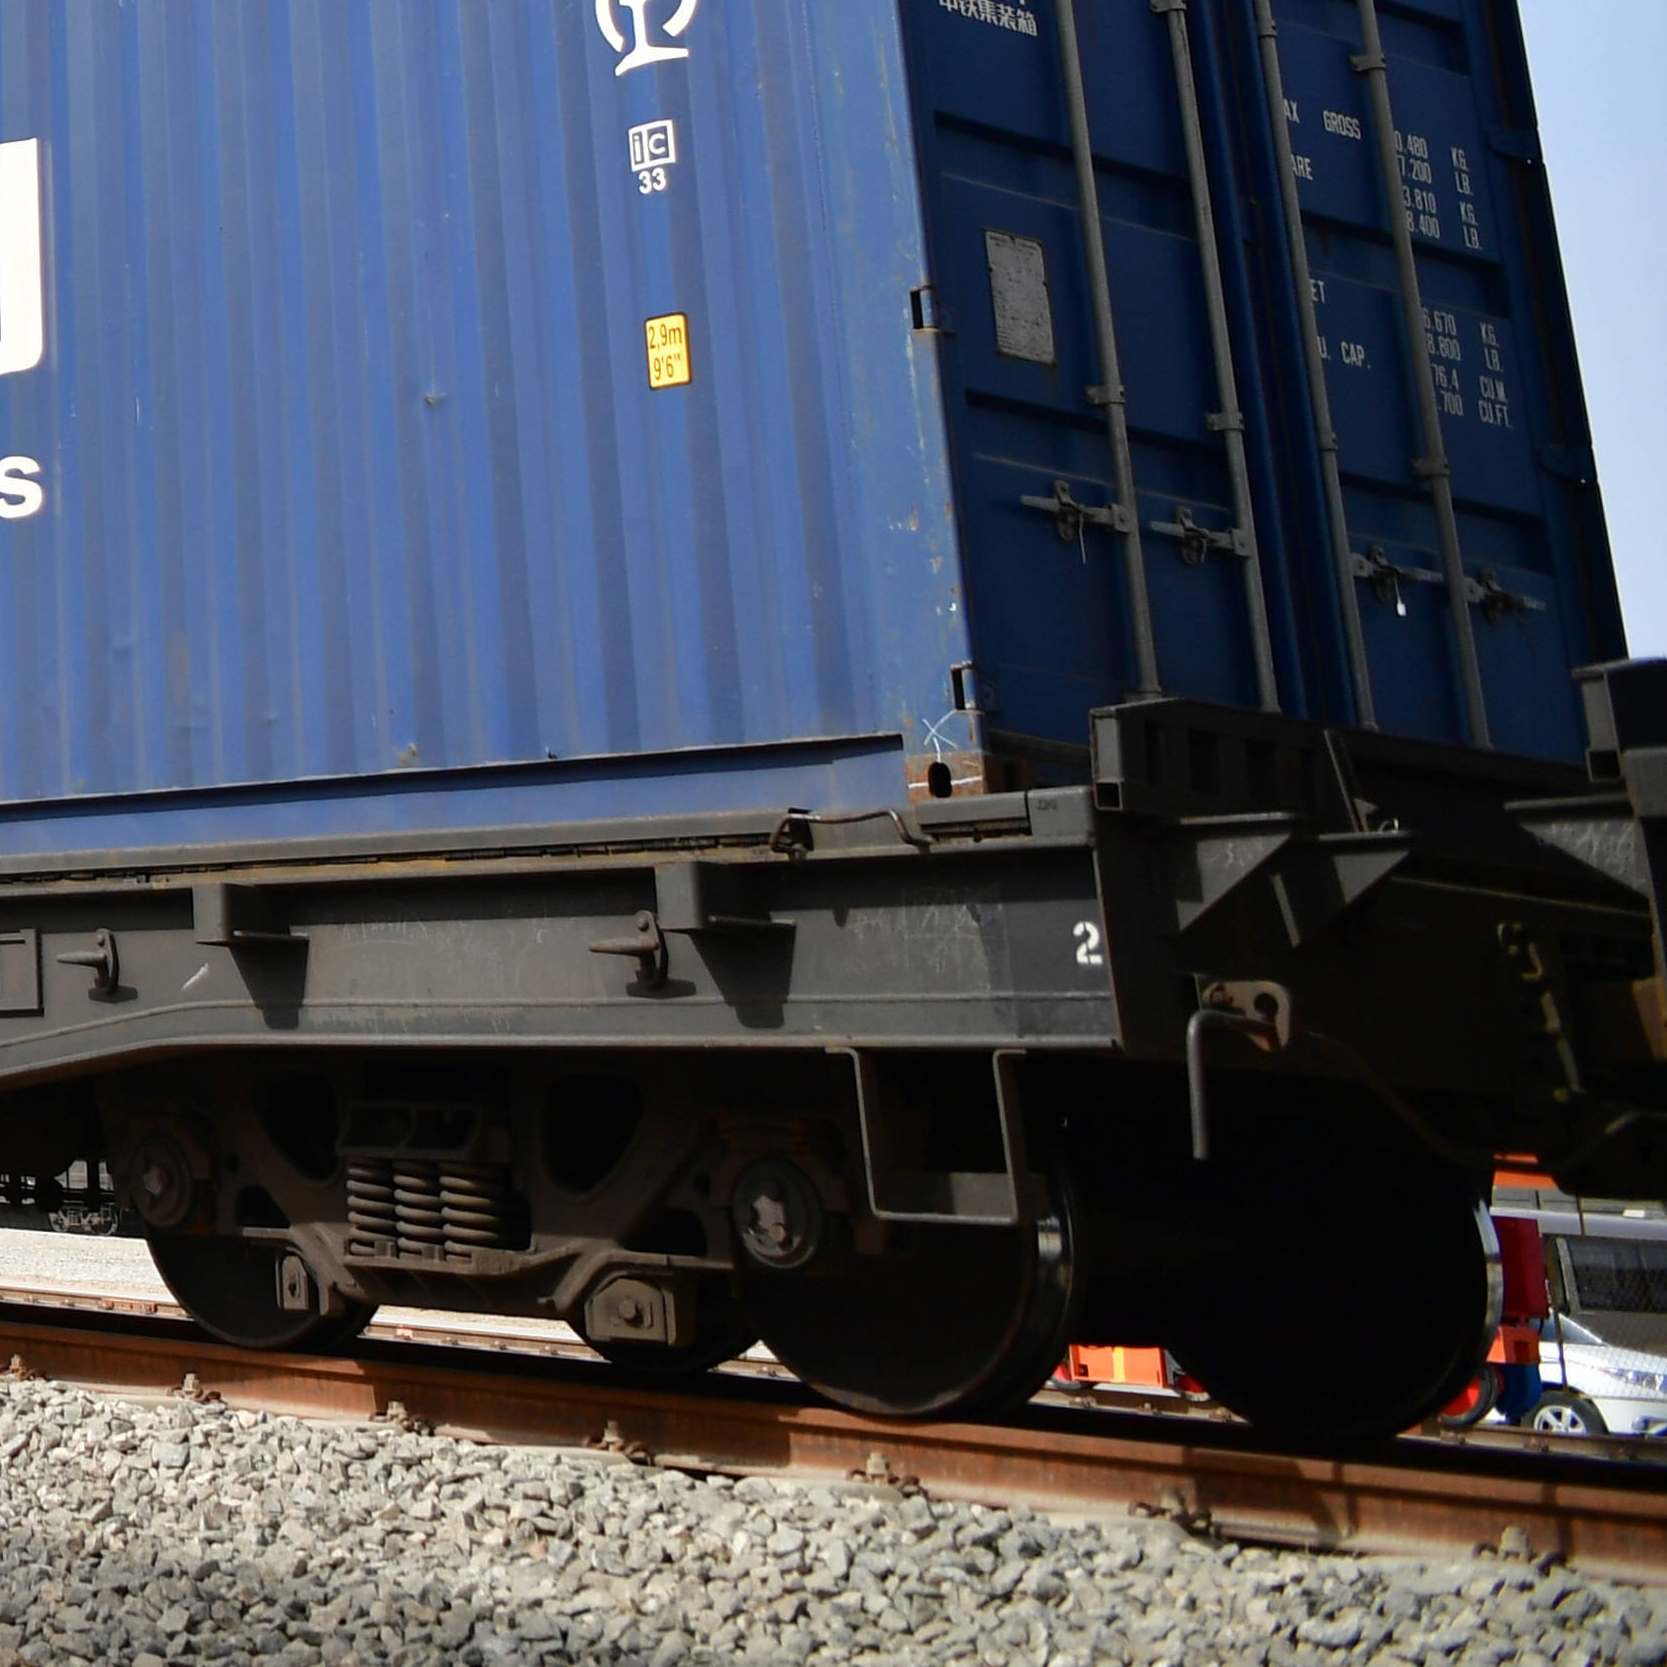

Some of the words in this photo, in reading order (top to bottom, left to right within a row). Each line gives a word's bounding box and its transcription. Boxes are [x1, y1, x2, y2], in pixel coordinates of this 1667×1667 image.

[1283, 98, 1300, 123] AX
[1323, 110, 1362, 140] GROSS
[1290, 154, 1313, 180] ARE
[638, 167, 667, 195] 33
[1309, 279, 1326, 303] ET
[1317, 336, 1331, 359] U.
[1073, 921, 1103, 965] 2
